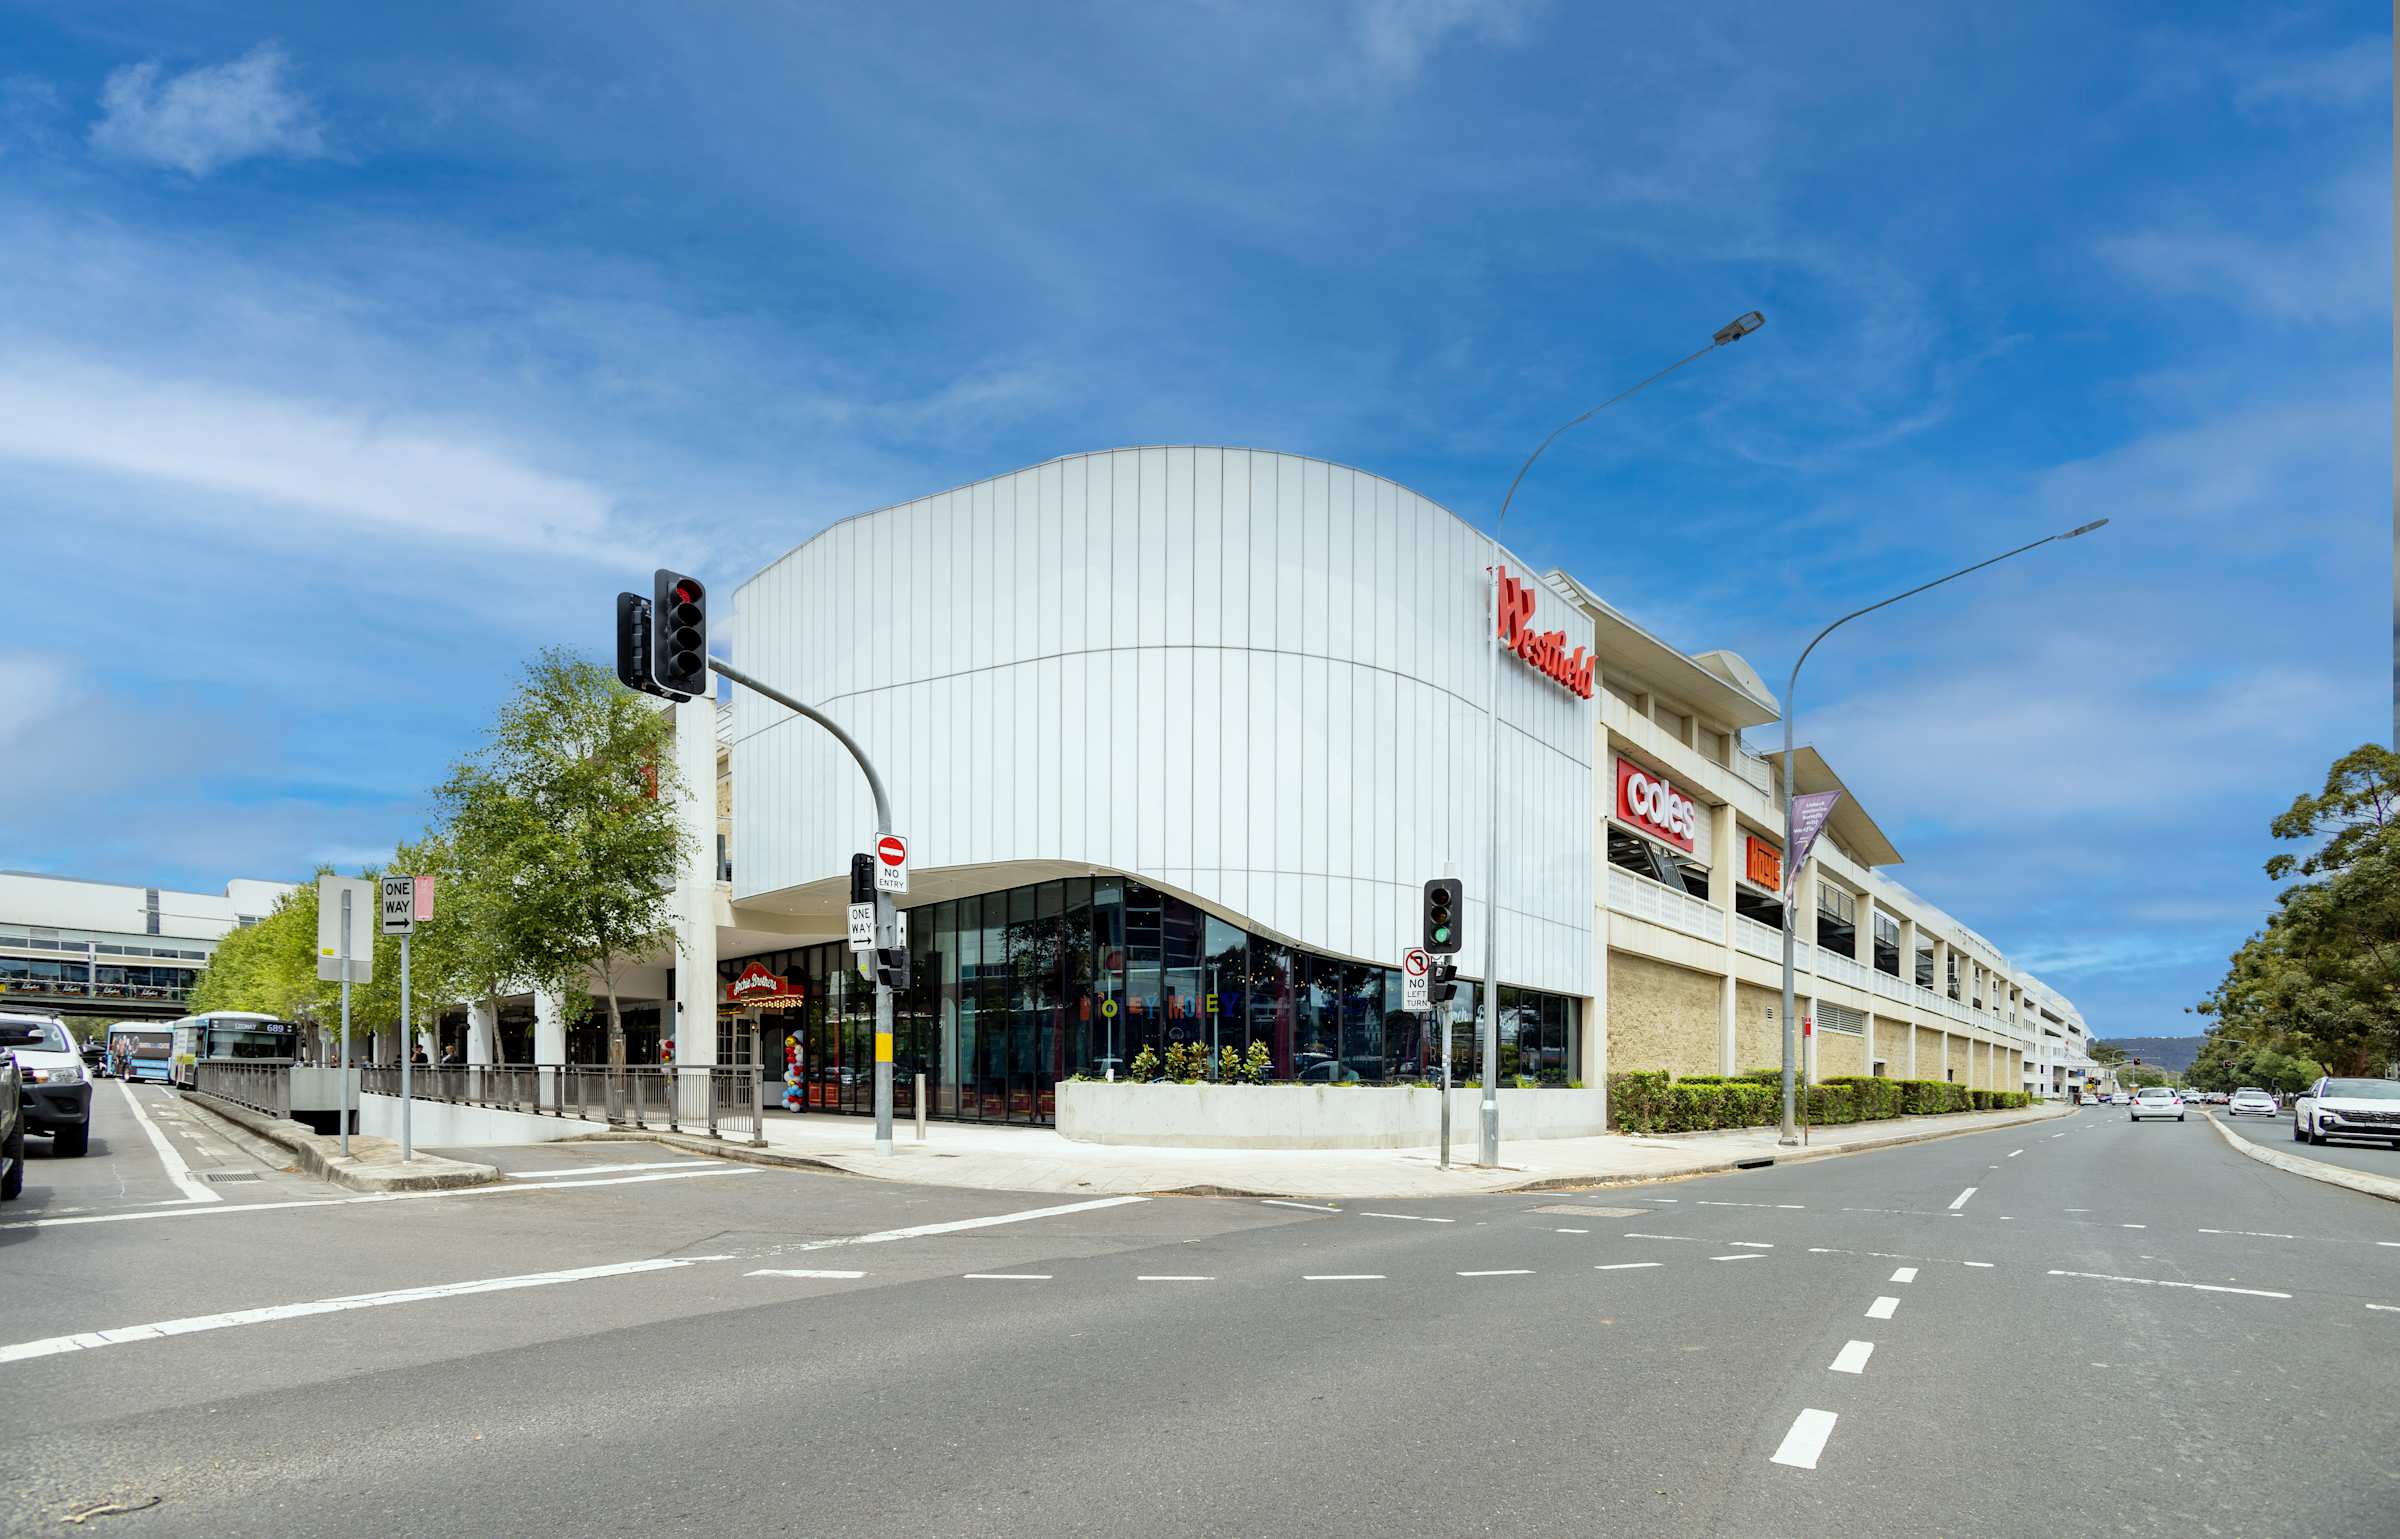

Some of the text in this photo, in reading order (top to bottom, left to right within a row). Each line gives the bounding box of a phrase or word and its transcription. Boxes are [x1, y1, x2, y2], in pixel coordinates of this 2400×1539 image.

[1486, 565, 1599, 700] Westfield
[1627, 772, 1694, 840] coles
[884, 868, 899, 879] NO
[385, 882, 410, 896] ONE
[879, 878, 905, 889] ENTRY
[385, 900, 410, 913] WAY
[852, 907, 871, 920] ONE
[851, 922, 872, 934] WAY
[1409, 978, 1425, 989] NO
[1407, 990, 1427, 999] LEFT
[1407, 999, 1428, 1008] TURN
[266, 1023, 285, 1033] 689
